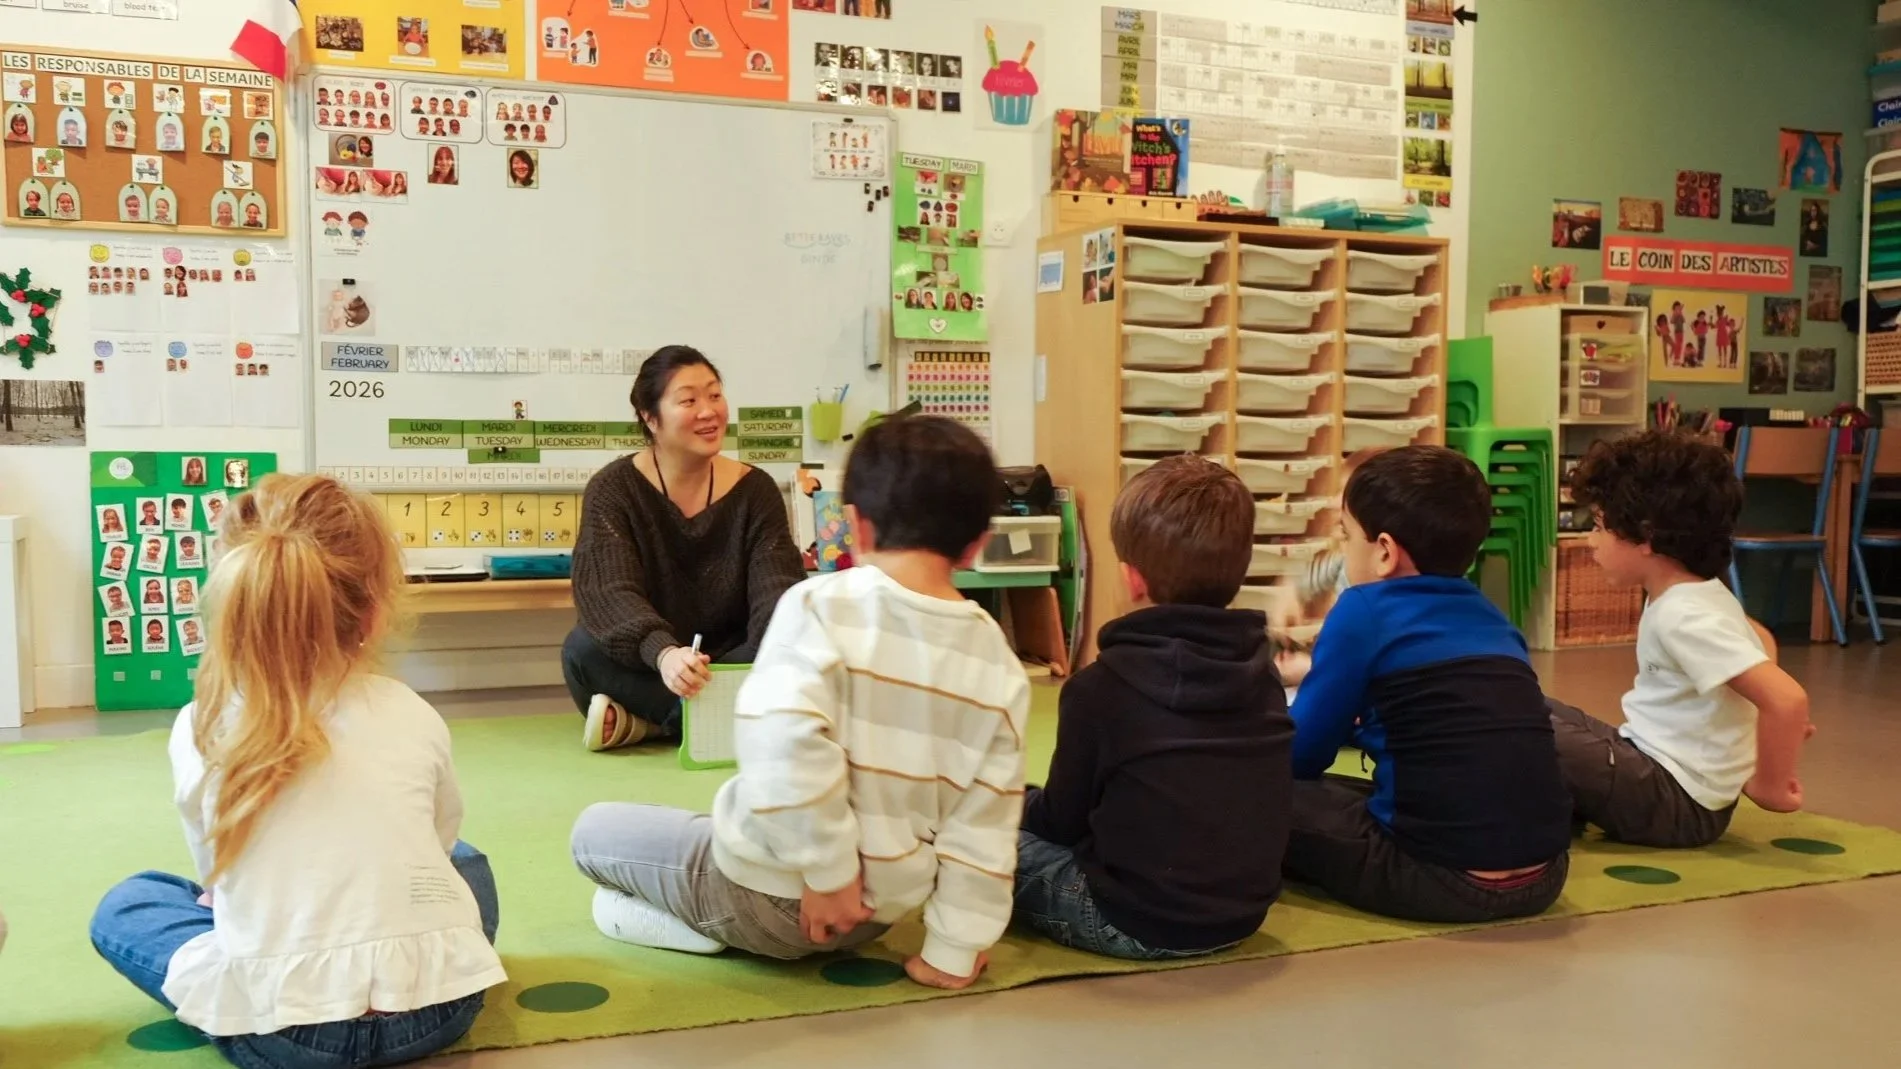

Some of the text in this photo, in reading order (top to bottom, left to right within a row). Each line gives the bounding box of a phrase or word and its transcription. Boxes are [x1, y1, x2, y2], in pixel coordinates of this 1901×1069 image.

[63, 1, 90, 9] bruise
[123, 2, 148, 11] blood
[3, 54, 272, 87] LES RESPONSABLES DE LA SEMAINE
[1135, 123, 1162, 133] What's
[903, 156, 978, 173] TUESDAY MARDI
[1131, 153, 1177, 168] itchen?
[1610, 250, 1788, 275] LE COIN DES ARTISTES
[337, 344, 384, 356] FÉVRIER
[331, 359, 390, 369] FEBRUARY
[329, 381, 385, 398] 2026
[750, 408, 787, 418] SAMEDI
[410, 422, 442, 433] LUNDI
[482, 422, 516, 433] MARDI
[543, 423, 597, 434] MERCREDI
[743, 422, 793, 432] SATURDAY
[402, 436, 450, 447] MONDAY
[475, 436, 523, 447] TUESDAY
[536, 436, 602, 448] WEDNESDAY
[741, 436, 794, 448] DIMANCHE
[748, 450, 788, 461] SUNDAY
[403, 500, 565, 517] 1 2 3 4 5
